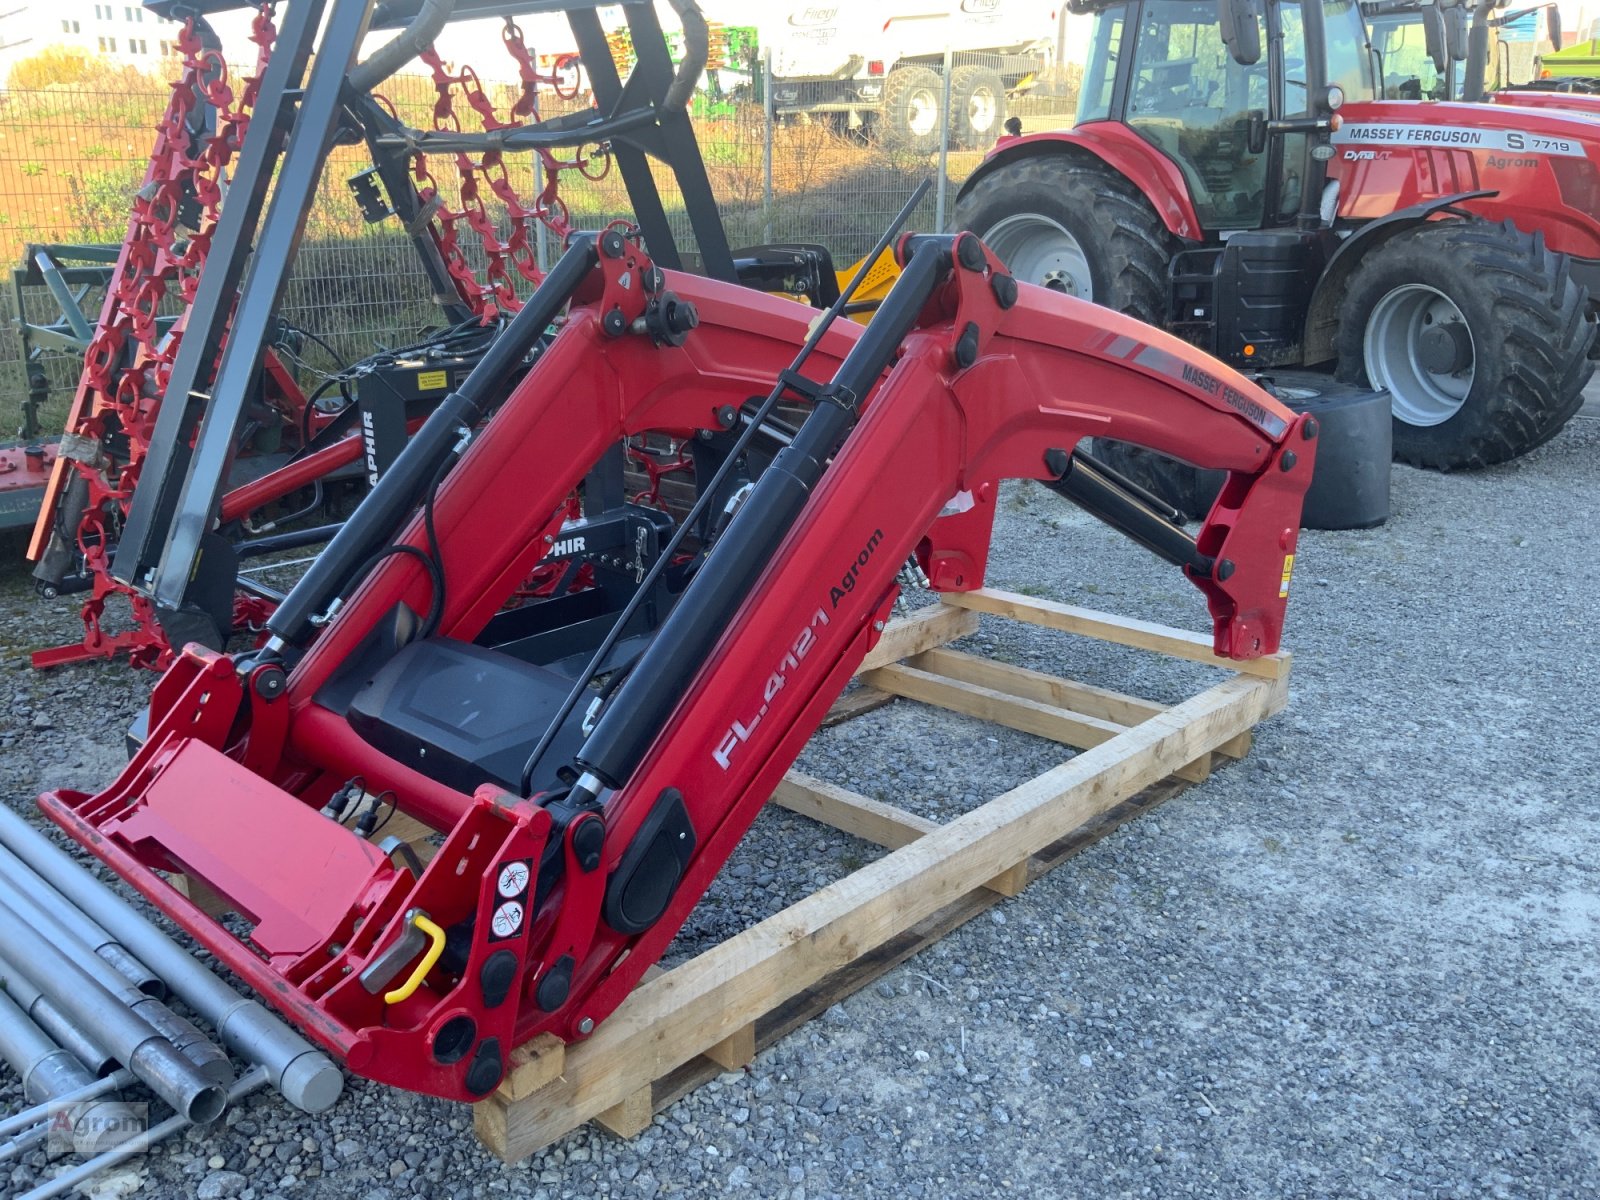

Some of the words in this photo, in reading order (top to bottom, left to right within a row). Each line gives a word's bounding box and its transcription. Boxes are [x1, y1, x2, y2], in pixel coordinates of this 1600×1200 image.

[1350, 128, 1404, 140] MASSEY
[1406, 129, 1482, 144] FERGUSON
[1506, 133, 1525, 150] S
[1531, 139, 1570, 152] 7719
[1486, 155, 1539, 169] Agrom
[1182, 364, 1221, 396] MASSEY
[1222, 385, 1266, 424] FERGUSON
[711, 606, 830, 771] FL.4121
[829, 528, 884, 609] Agrom
